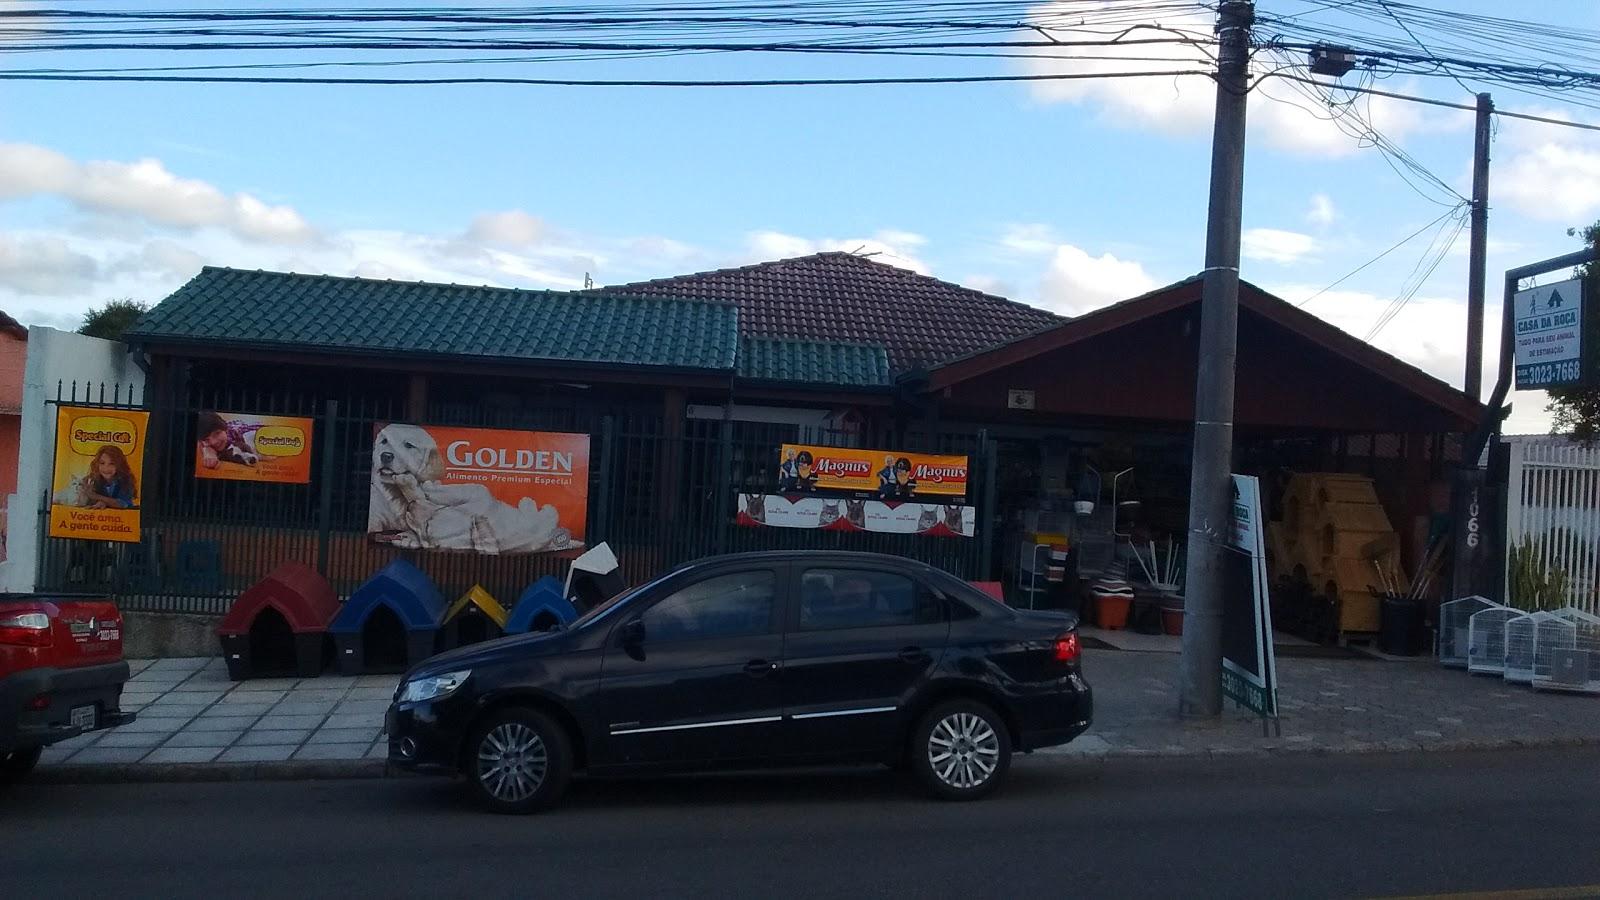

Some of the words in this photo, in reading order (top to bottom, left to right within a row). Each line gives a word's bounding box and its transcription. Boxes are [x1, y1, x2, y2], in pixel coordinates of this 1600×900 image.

[1518, 319, 1539, 333] CASA
[1541, 317, 1552, 329] DA
[1532, 336, 1545, 344] PARA
[1546, 334, 1555, 342] SEU
[1529, 361, 1581, 385] 3023-7668
[75, 429, 111, 442] Special
[258, 435, 284, 446] Special
[446, 440, 573, 472] GOLDEN
[811, 457, 870, 477] Magnus
[909, 464, 967, 483] Magnus
[446, 472, 488, 481] Alimento
[491, 475, 532, 484] Premium
[534, 476, 573, 486] Especial
[70, 511, 95, 521] Você
[97, 514, 123, 523] ama.
[59, 520, 68, 529] A
[70, 521, 99, 532] gente
[101, 523, 133, 533] cuida.
